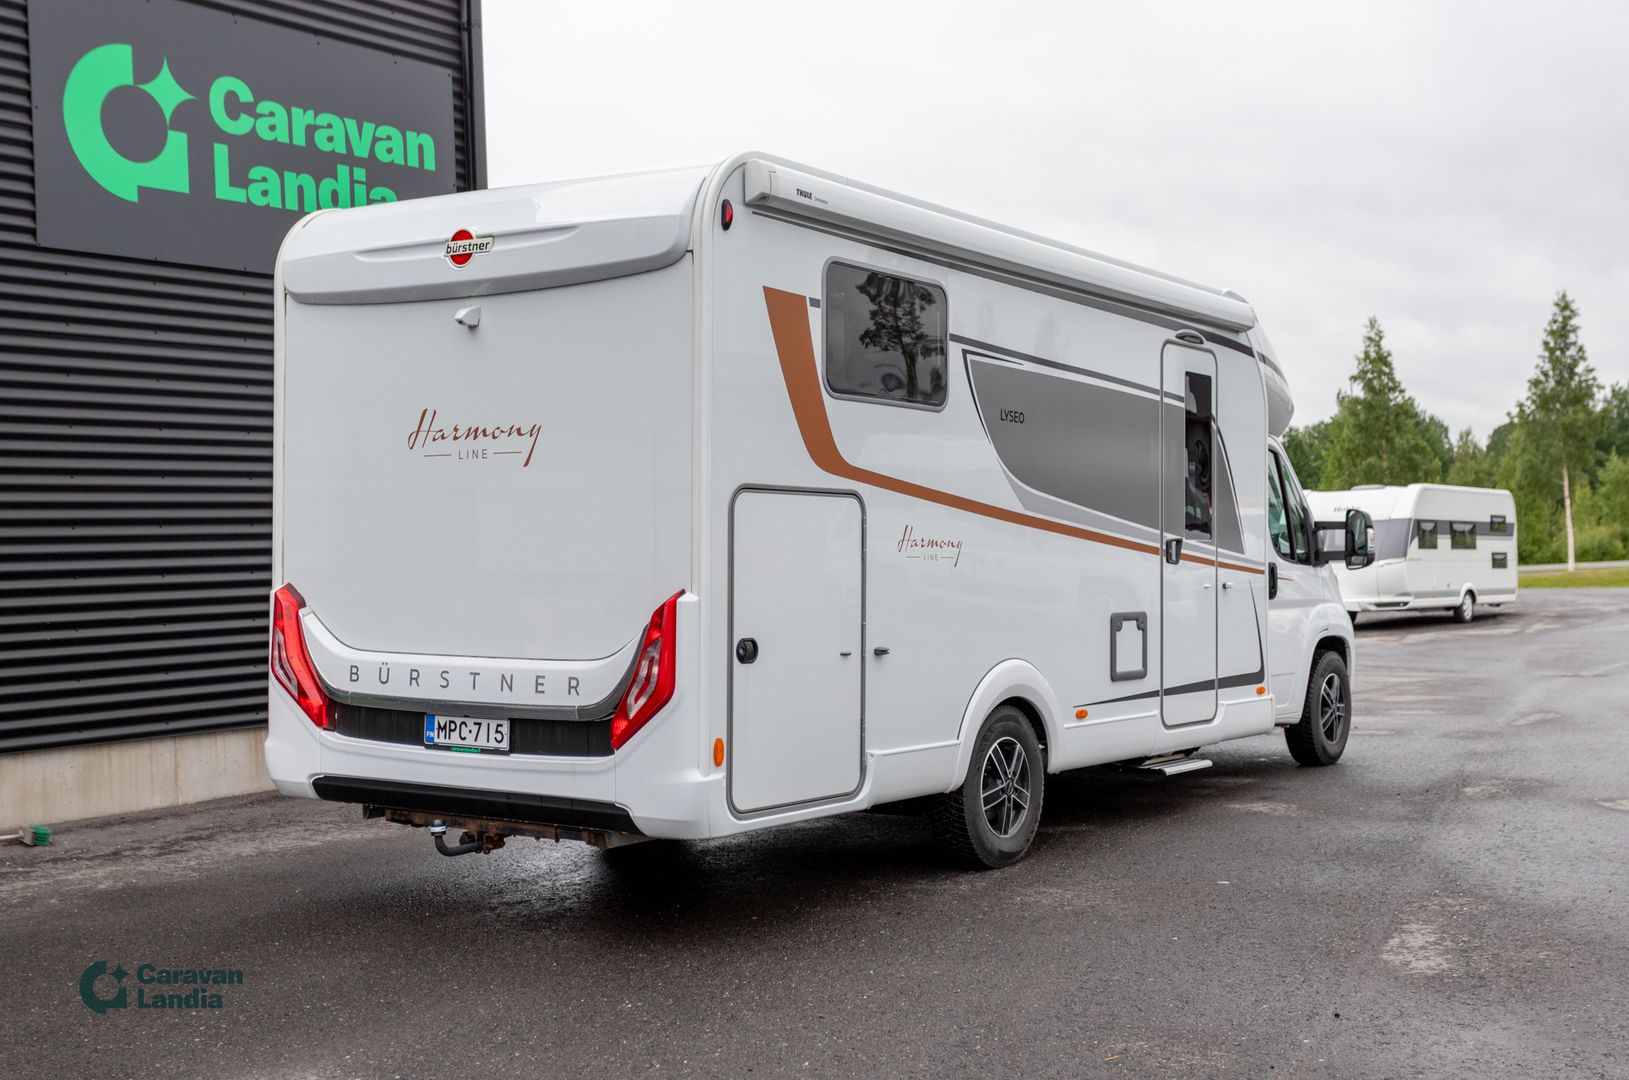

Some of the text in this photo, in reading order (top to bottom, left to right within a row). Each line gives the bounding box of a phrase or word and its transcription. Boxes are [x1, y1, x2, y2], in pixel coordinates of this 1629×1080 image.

[209, 75, 436, 171] Caravan
[446, 242, 490, 254] bürstner
[1000, 408, 1025, 424] LYSEO
[407, 408, 542, 467] Harmony
[458, 448, 488, 460] LINE
[897, 524, 963, 567] Harmony
[923, 553, 939, 562] LINE
[349, 662, 580, 696] BÜRSTNER
